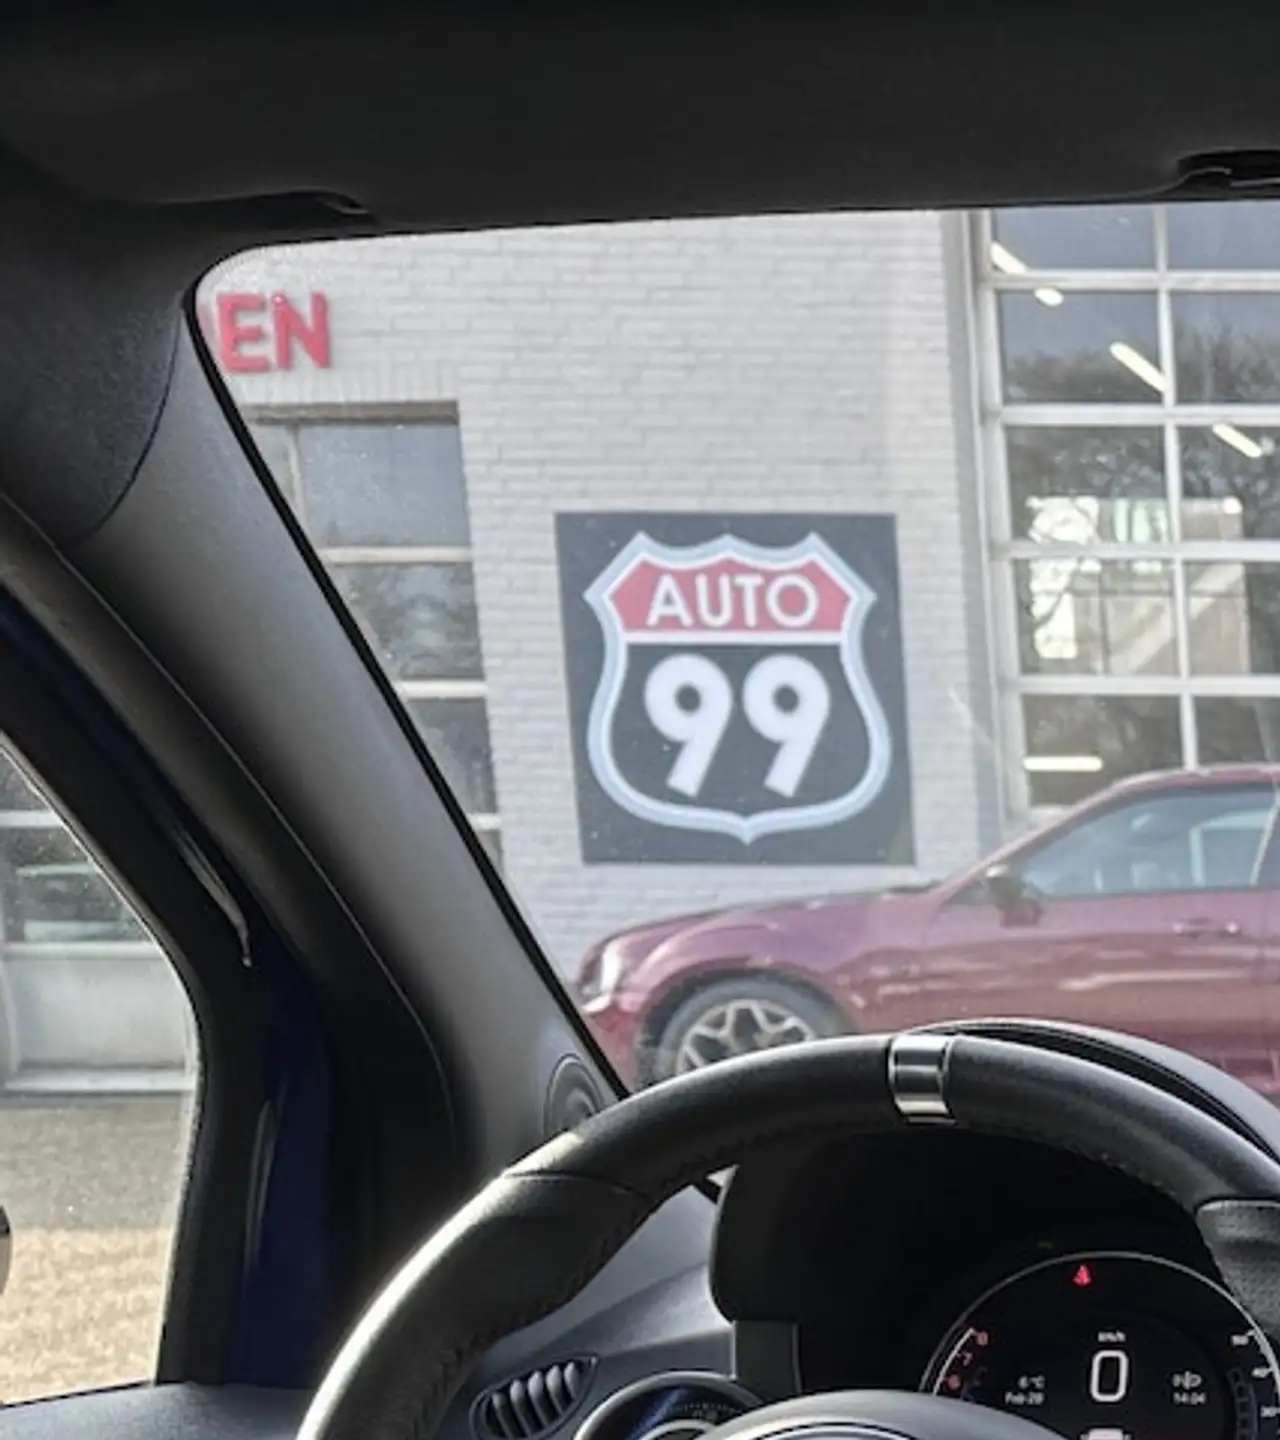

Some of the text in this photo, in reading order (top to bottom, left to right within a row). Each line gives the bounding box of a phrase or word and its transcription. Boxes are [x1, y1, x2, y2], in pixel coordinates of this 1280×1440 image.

[198, 290, 332, 374] EN
[646, 573, 820, 629] AUTO
[644, 653, 831, 799] 99
[1088, 1349, 1130, 1403] 0
